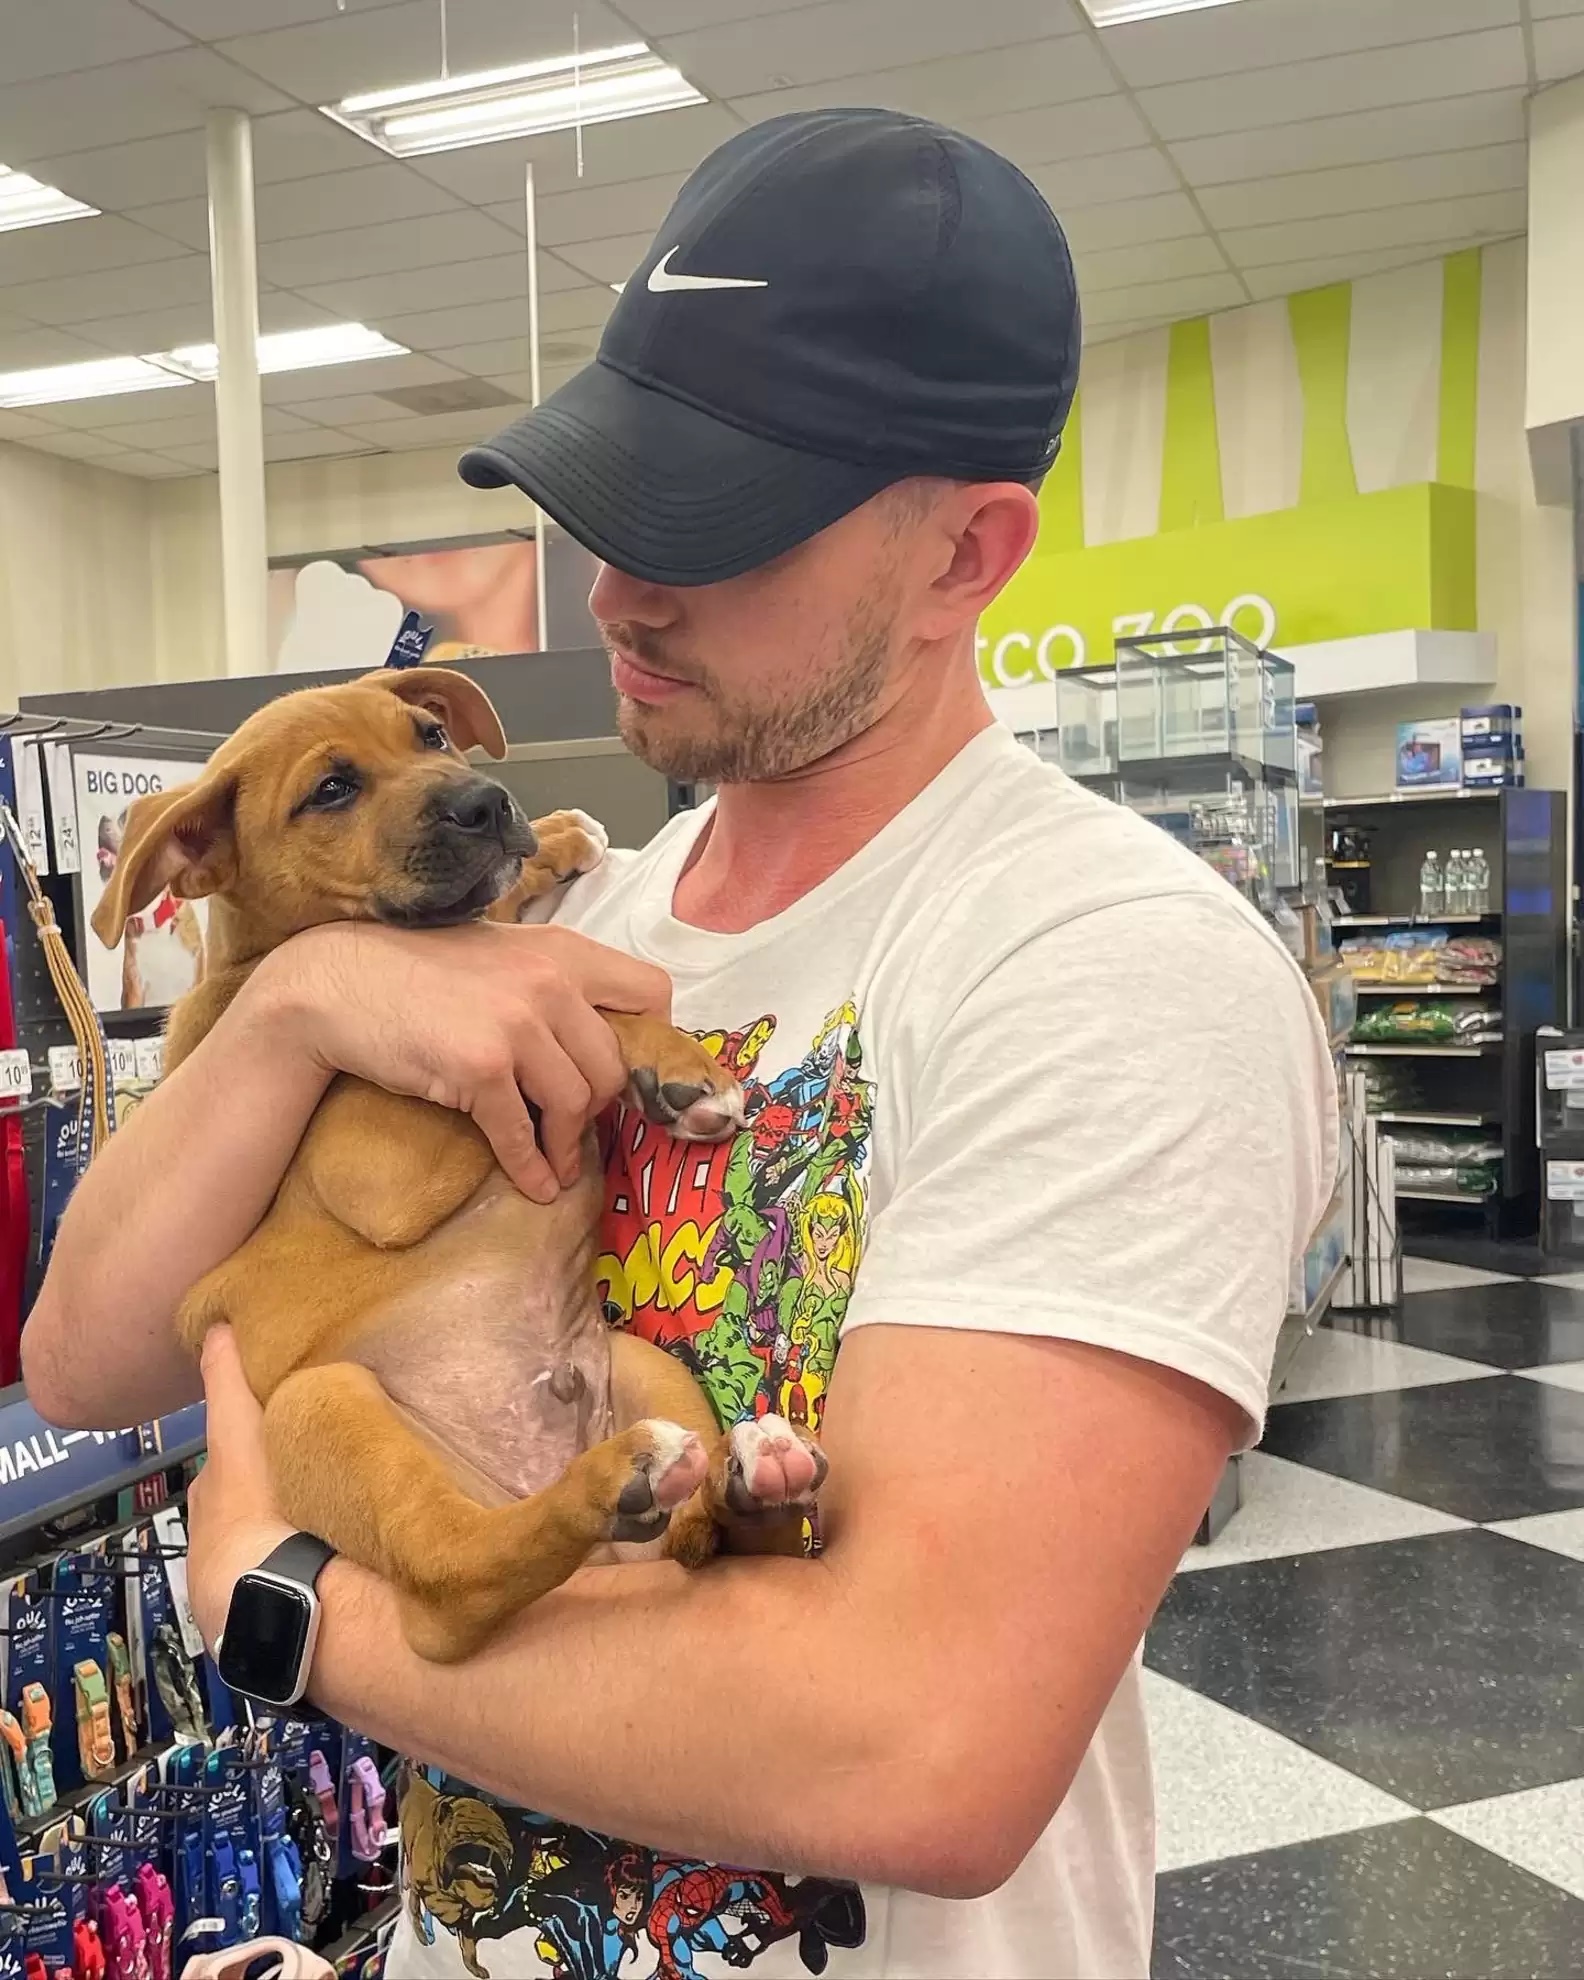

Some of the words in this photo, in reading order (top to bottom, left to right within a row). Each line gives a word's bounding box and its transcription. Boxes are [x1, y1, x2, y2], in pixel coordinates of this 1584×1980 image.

[87, 770, 118, 794] BIG
[122, 773, 163, 795] DOG
[57, 1119, 78, 1149] YOU
